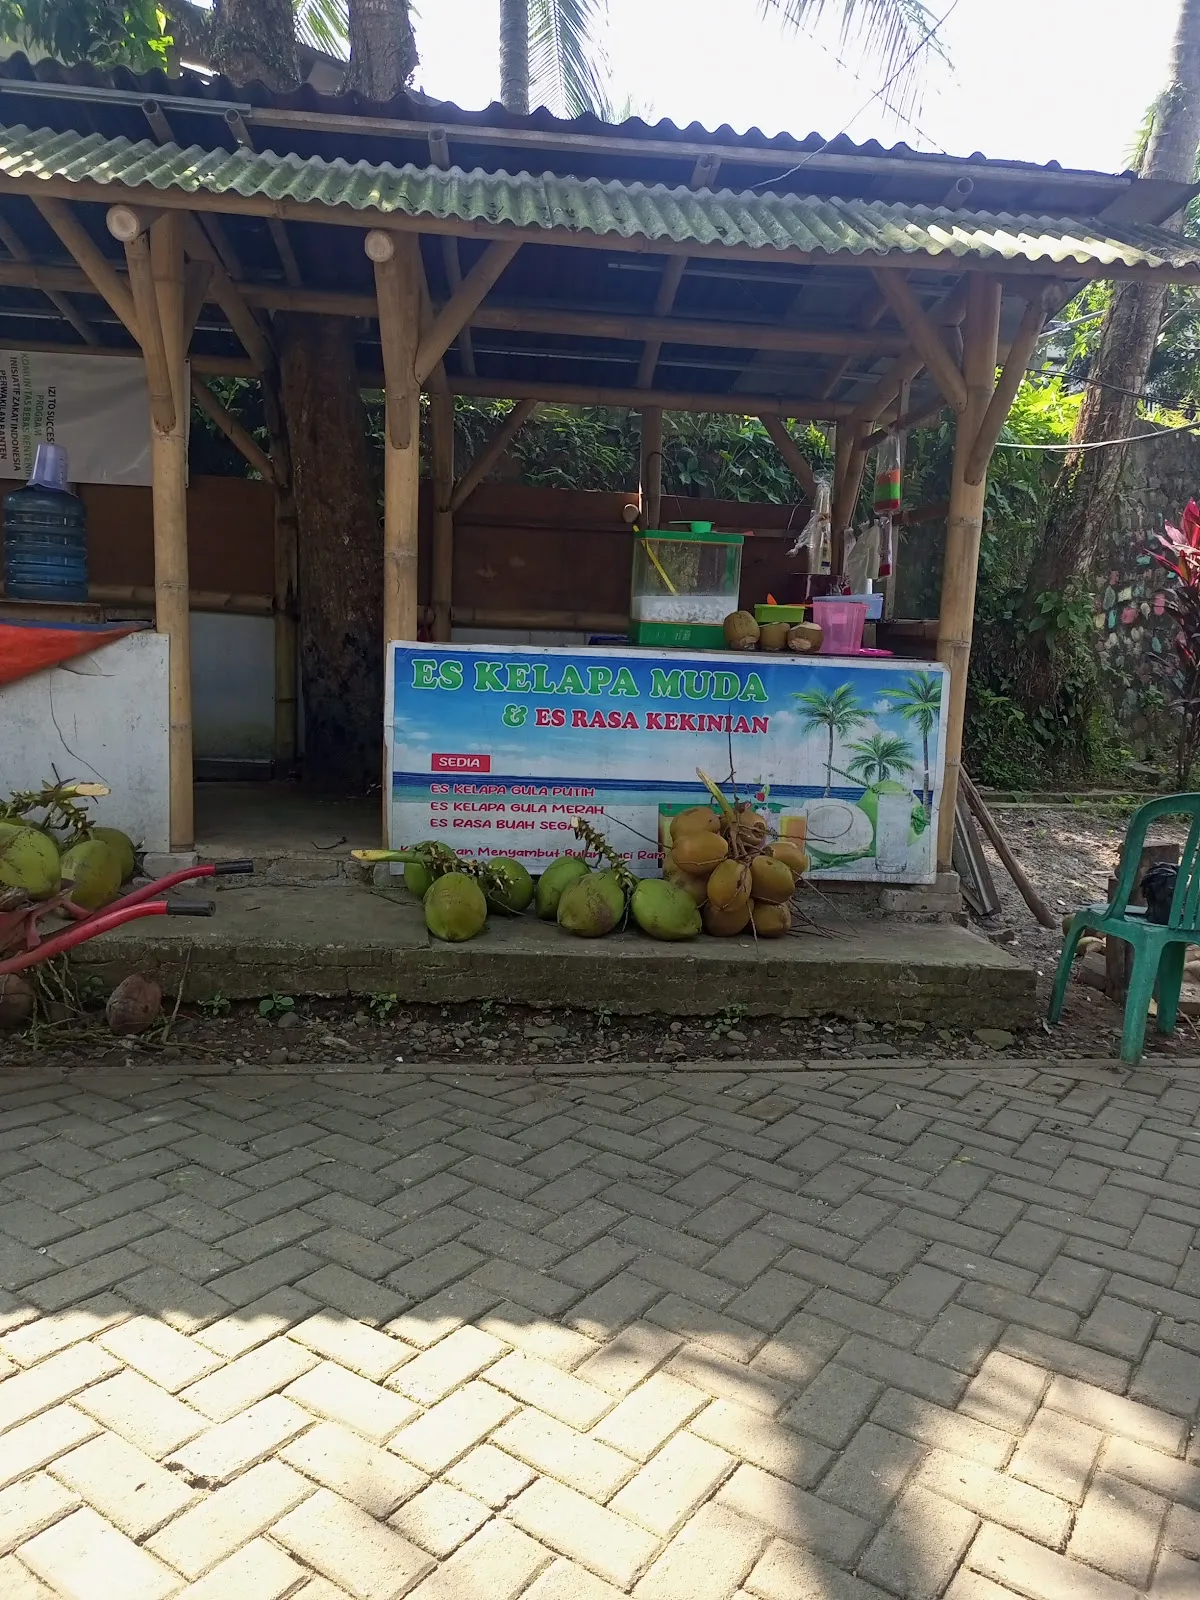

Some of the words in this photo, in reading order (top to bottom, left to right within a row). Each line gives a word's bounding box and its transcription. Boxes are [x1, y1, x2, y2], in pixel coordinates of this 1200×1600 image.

[10, 357, 20, 396] INISIATIF
[21, 353, 32, 405] KOMUNITAS
[48, 386, 56, 398] IZI
[48, 399, 56, 410] TO
[11, 396, 20, 422] ZAKAT
[22, 407, 31, 433] BEBAS
[34, 394, 44, 436] PROGRAM
[46, 411, 55, 445] SUCCES
[11, 424, 21, 471] INDONESIA
[411, 659, 464, 690] ES
[474, 662, 640, 697] KELAPA
[649, 669, 768, 703] MUDA
[502, 704, 528, 727] &
[535, 708, 568, 728] ES
[571, 709, 639, 731] RASA
[645, 712, 770, 734] KEKINIAN
[438, 756, 480, 768] SEDIA
[430, 783, 449, 795] ES
[453, 783, 507, 796] KELAPA
[511, 785, 549, 797] GULA
[552, 786, 596, 798] PUTIH
[430, 801, 449, 812] ES
[453, 802, 506, 813] KELAPA
[510, 803, 548, 814] GULA
[552, 804, 605, 815] MERAH
[430, 817, 448, 828] ES
[453, 818, 492, 830] RASA
[496, 819, 535, 831] BUAH
[477, 847, 560, 859] Menyambut
[637, 850, 667, 860] Ram
